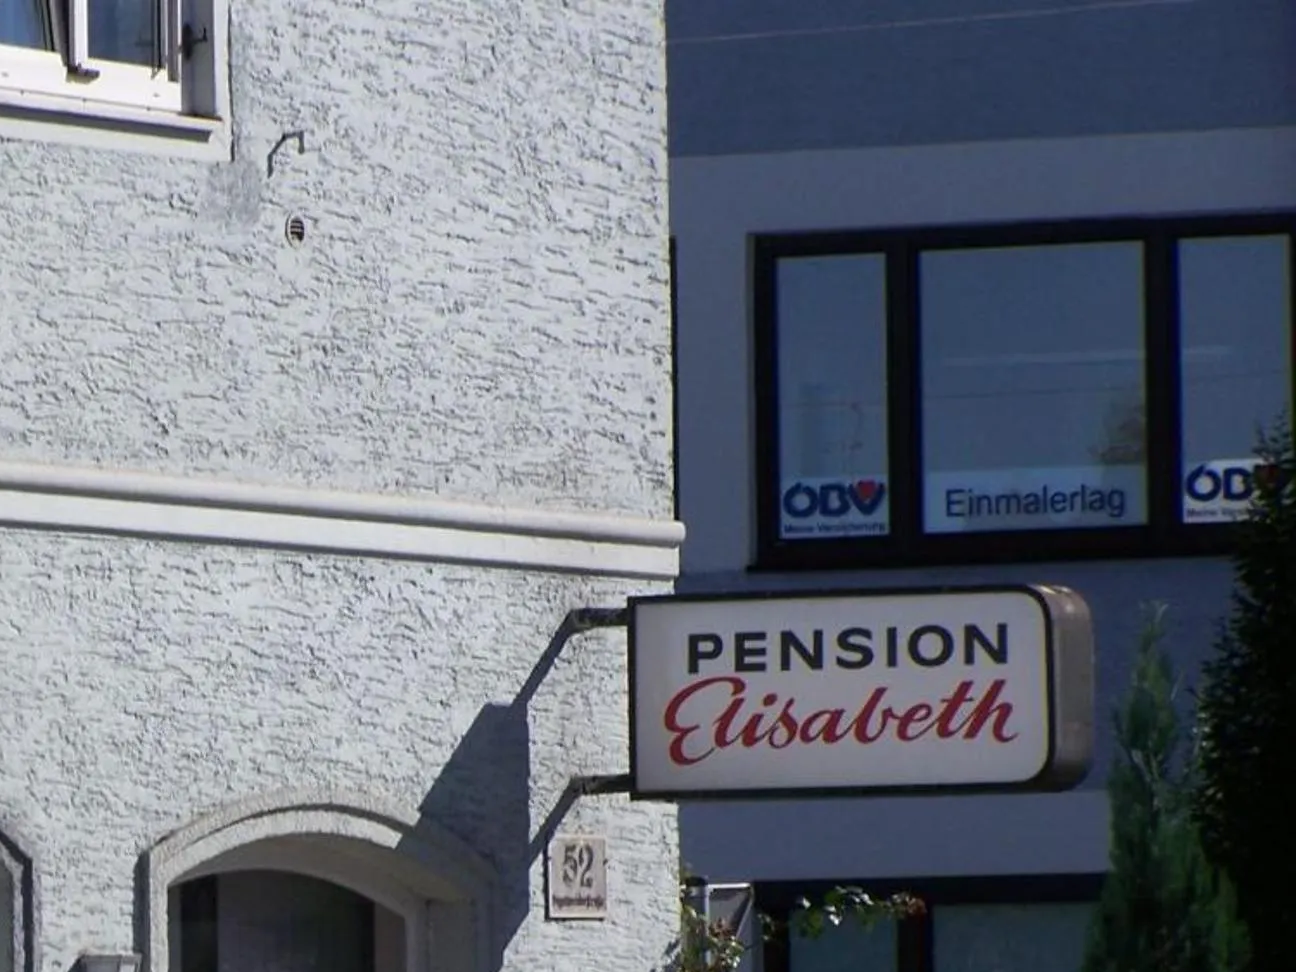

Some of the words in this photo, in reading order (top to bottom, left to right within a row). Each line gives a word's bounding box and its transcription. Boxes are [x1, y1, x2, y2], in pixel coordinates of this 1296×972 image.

[945, 484, 1126, 518] Einmalerlag
[687, 623, 1008, 674] PENSION
[663, 676, 1018, 766] Elisabeth
[563, 844, 593, 888] 52
